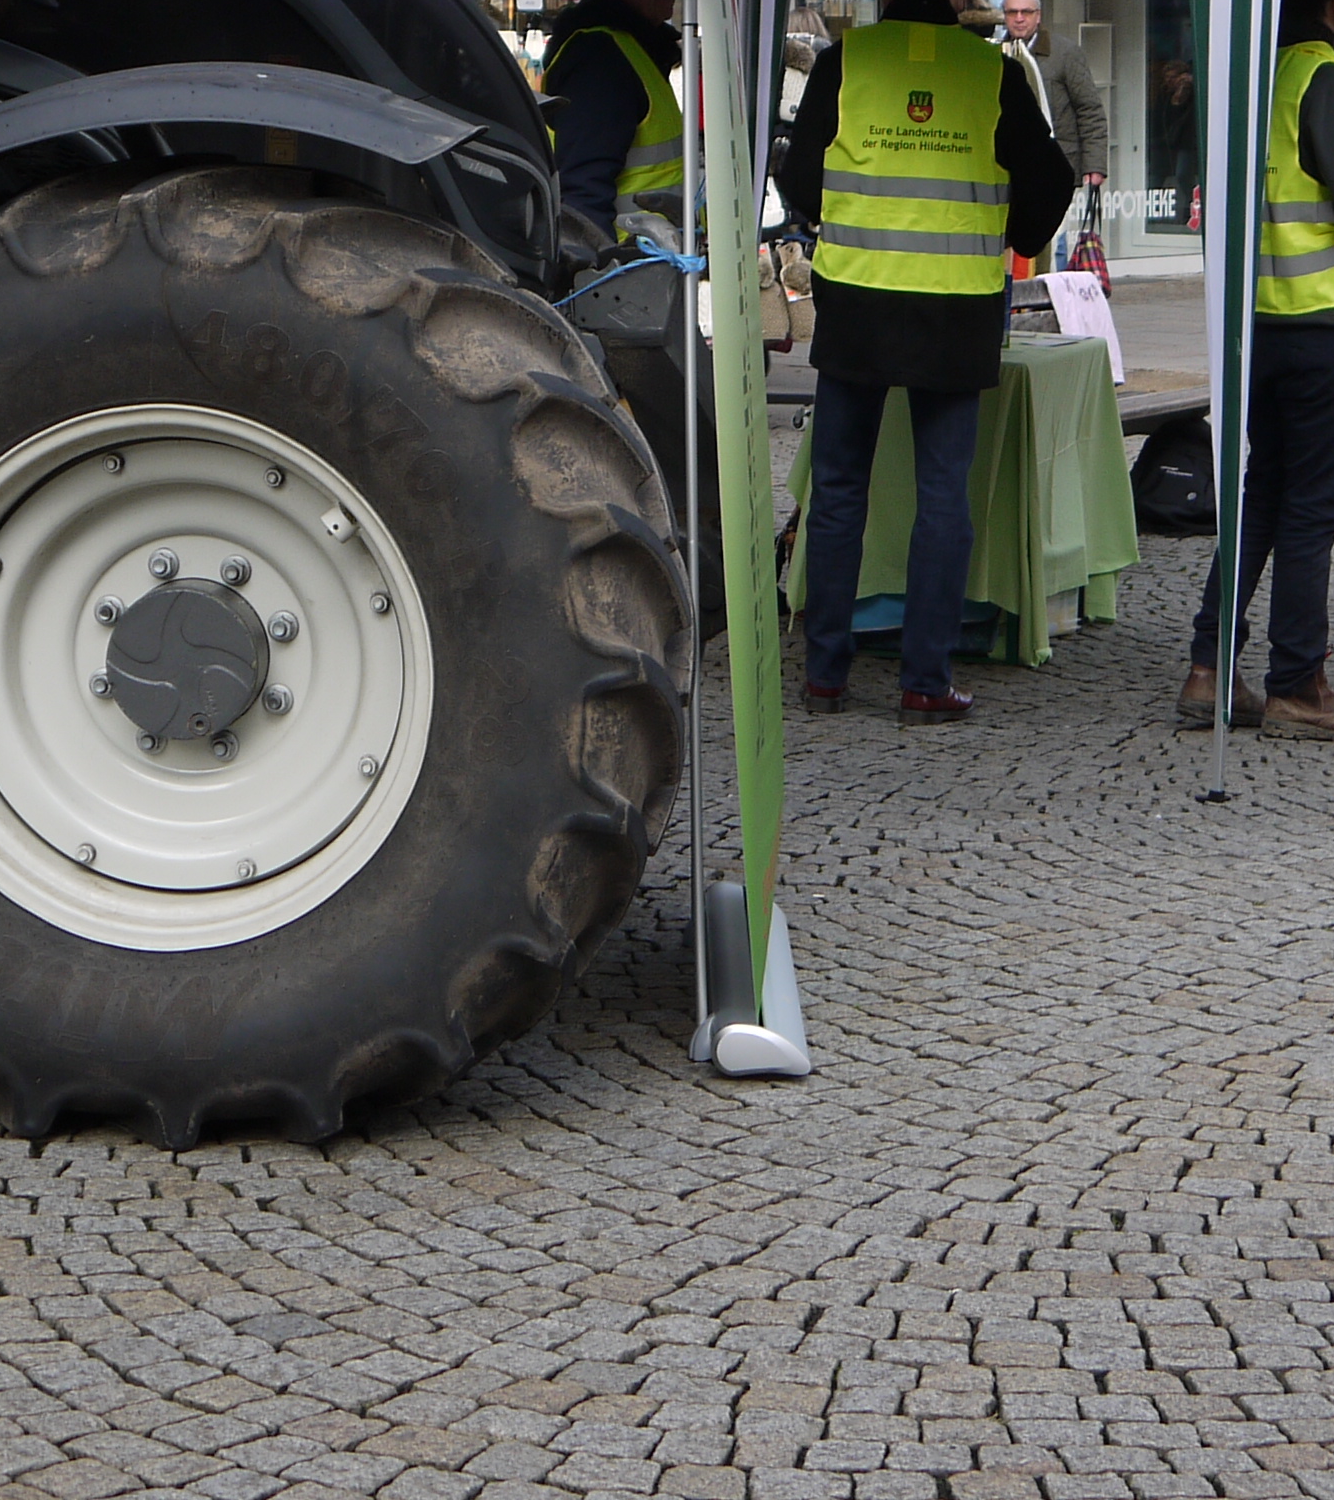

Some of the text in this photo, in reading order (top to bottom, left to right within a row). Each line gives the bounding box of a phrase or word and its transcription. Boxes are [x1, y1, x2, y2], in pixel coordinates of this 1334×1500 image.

[869, 124, 893, 136] Eure
[896, 126, 950, 139] Landwirte
[862, 138, 878, 149] der
[880, 138, 917, 152] Region
[1103, 188, 1177, 220] APOTHEKE
